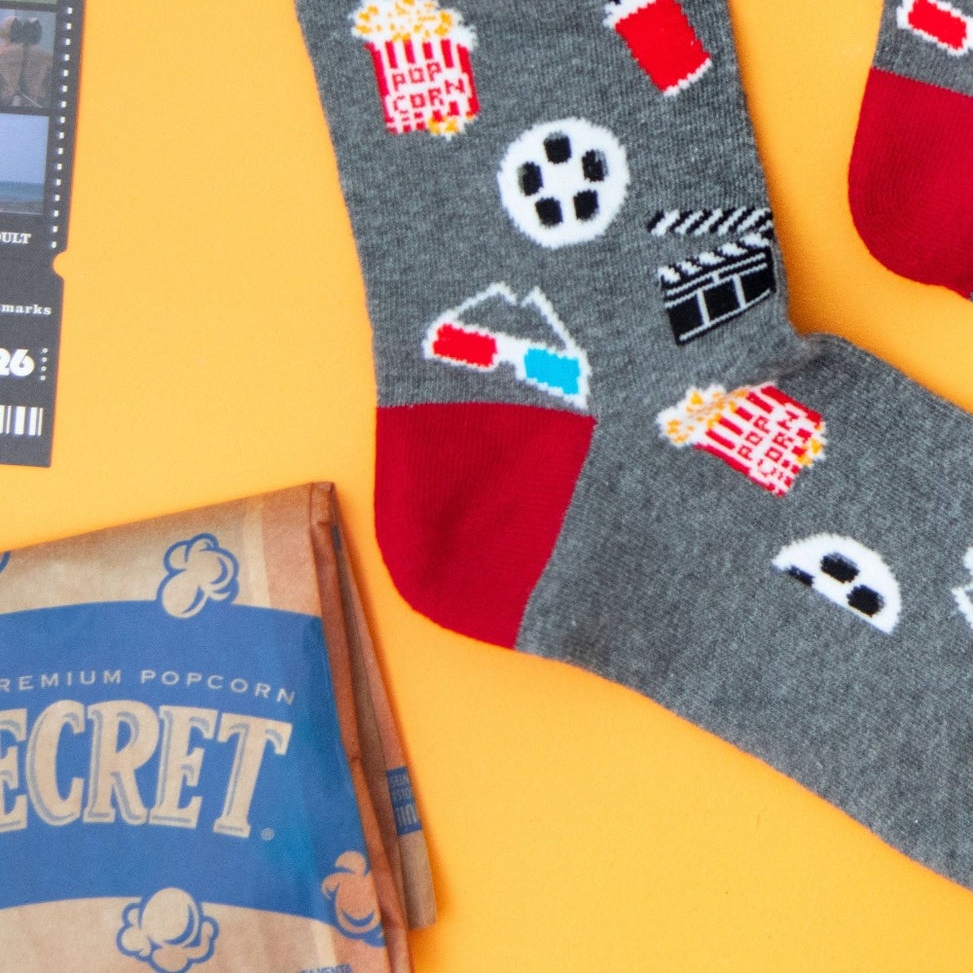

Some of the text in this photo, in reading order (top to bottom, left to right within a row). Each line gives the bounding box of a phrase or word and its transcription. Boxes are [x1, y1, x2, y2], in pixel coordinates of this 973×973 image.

[392, 62, 441, 91] POP
[393, 78, 465, 115] CORN
[1, 303, 52, 316] marks
[737, 416, 771, 461] POP
[757, 409, 799, 477] CORN
[141, 669, 297, 706] POPCORN
